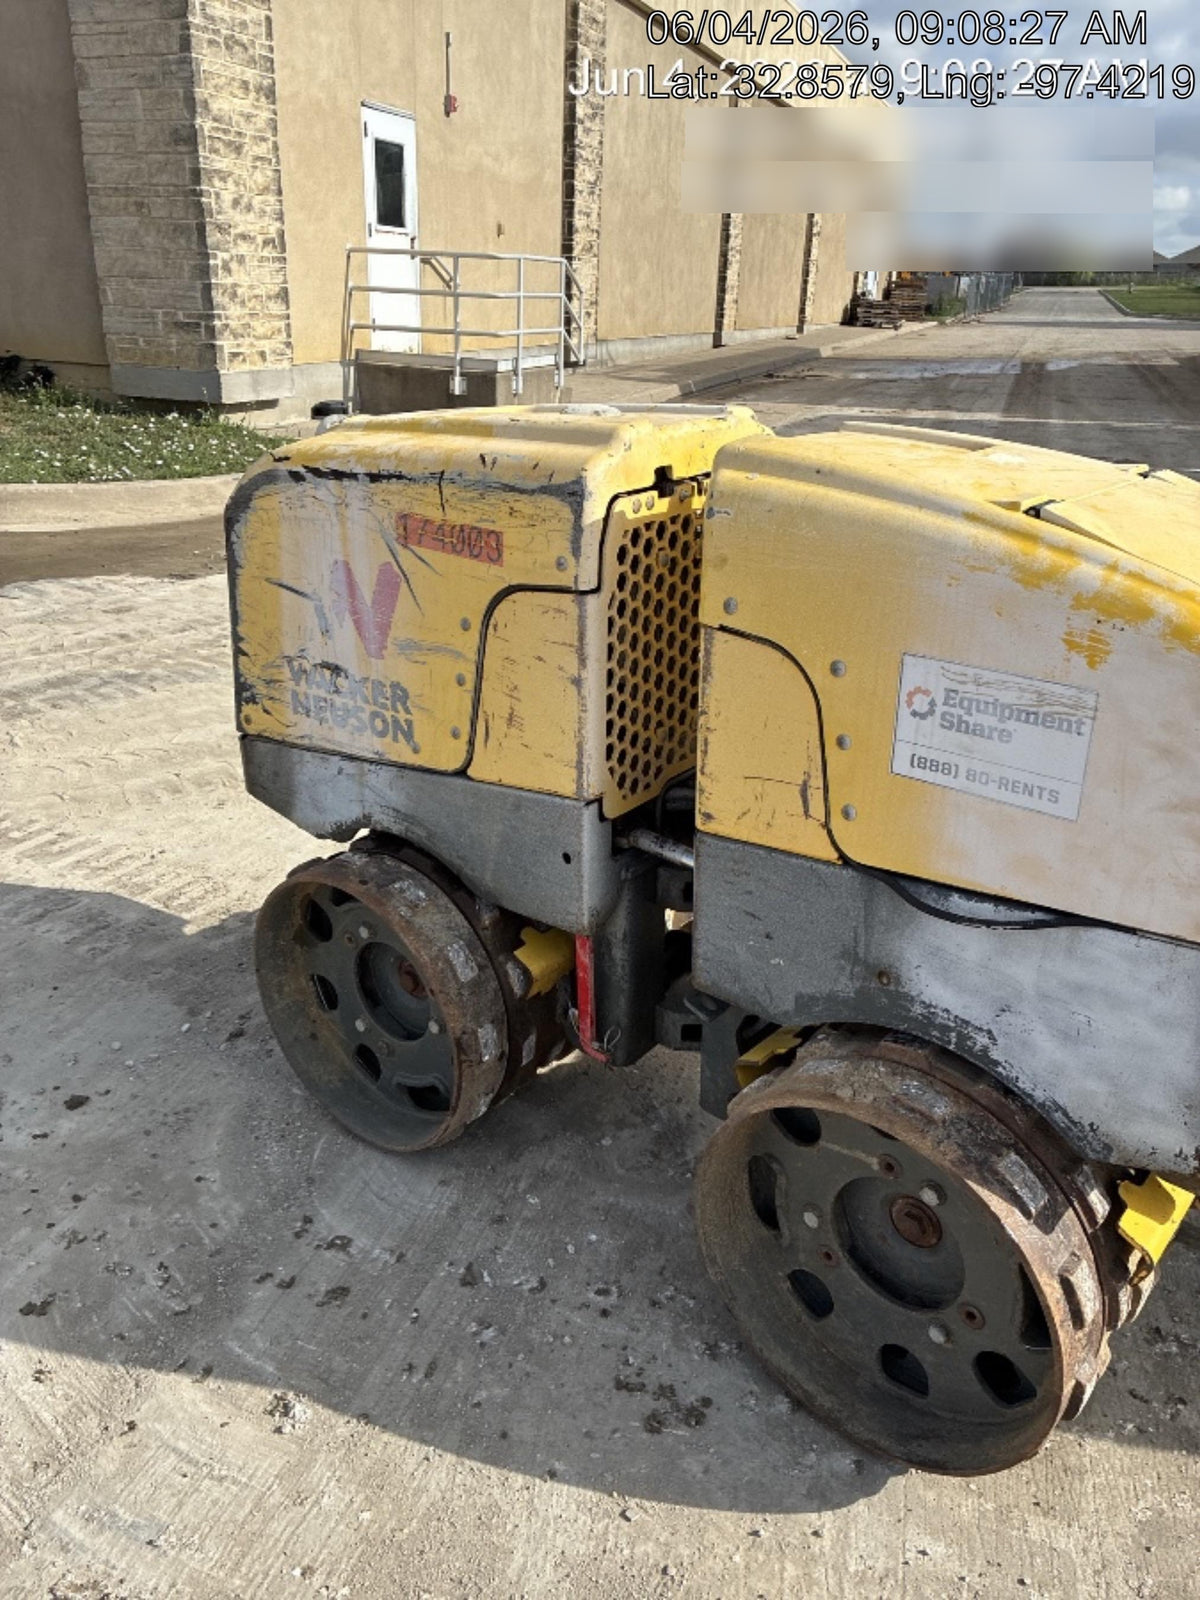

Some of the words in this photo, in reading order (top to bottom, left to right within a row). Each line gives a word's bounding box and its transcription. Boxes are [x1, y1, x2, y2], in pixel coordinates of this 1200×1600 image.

[939, 710, 1013, 744] Share
[942, 687, 1086, 737] Equipment
[909, 752, 960, 779] (888)
[965, 767, 1061, 805] 80-RENTS
